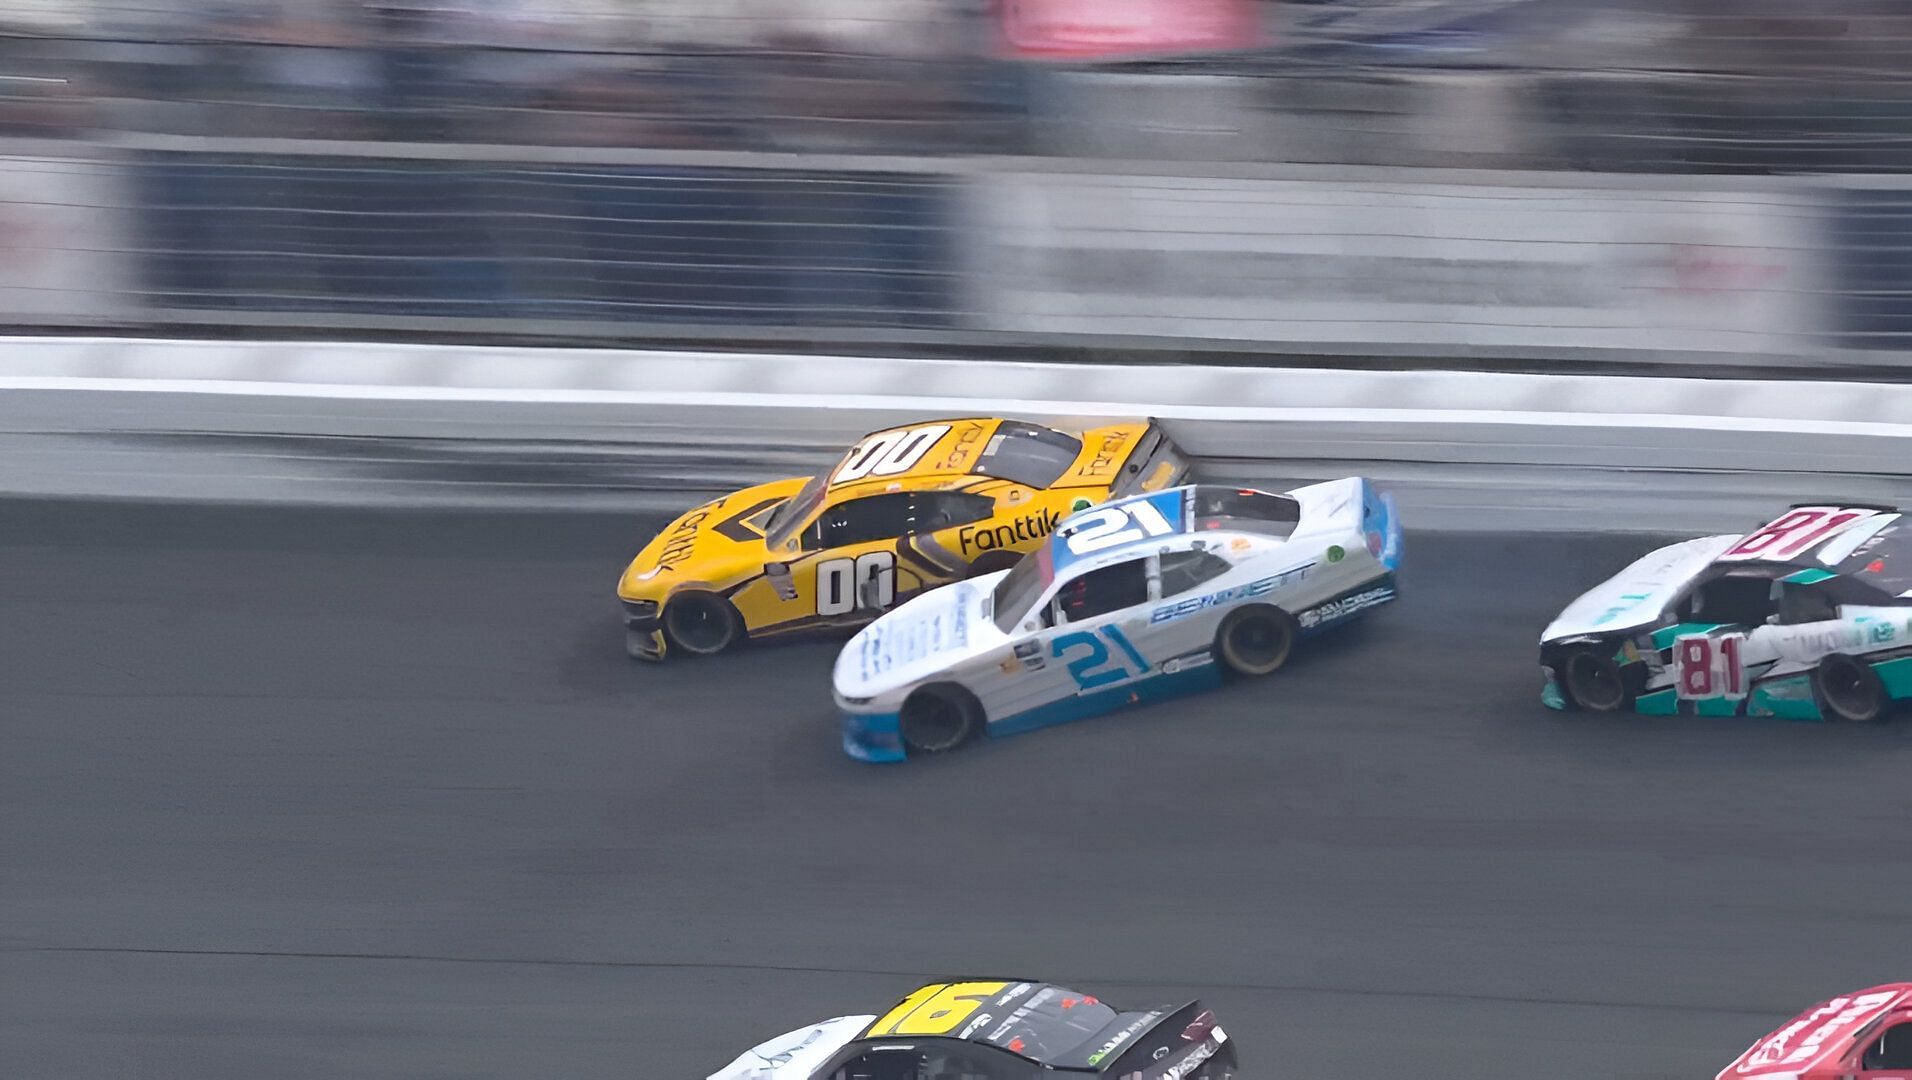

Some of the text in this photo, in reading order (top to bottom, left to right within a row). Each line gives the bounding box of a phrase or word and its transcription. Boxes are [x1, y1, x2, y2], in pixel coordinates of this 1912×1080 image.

[832, 425, 952, 485] 00
[959, 507, 1061, 556] Fanttik
[1056, 500, 1173, 555] 21
[1724, 508, 1868, 558] 81
[817, 551, 896, 617] 00
[1052, 624, 1149, 689] 21
[1679, 636, 1744, 698] 81
[866, 982, 1008, 1038] 16
